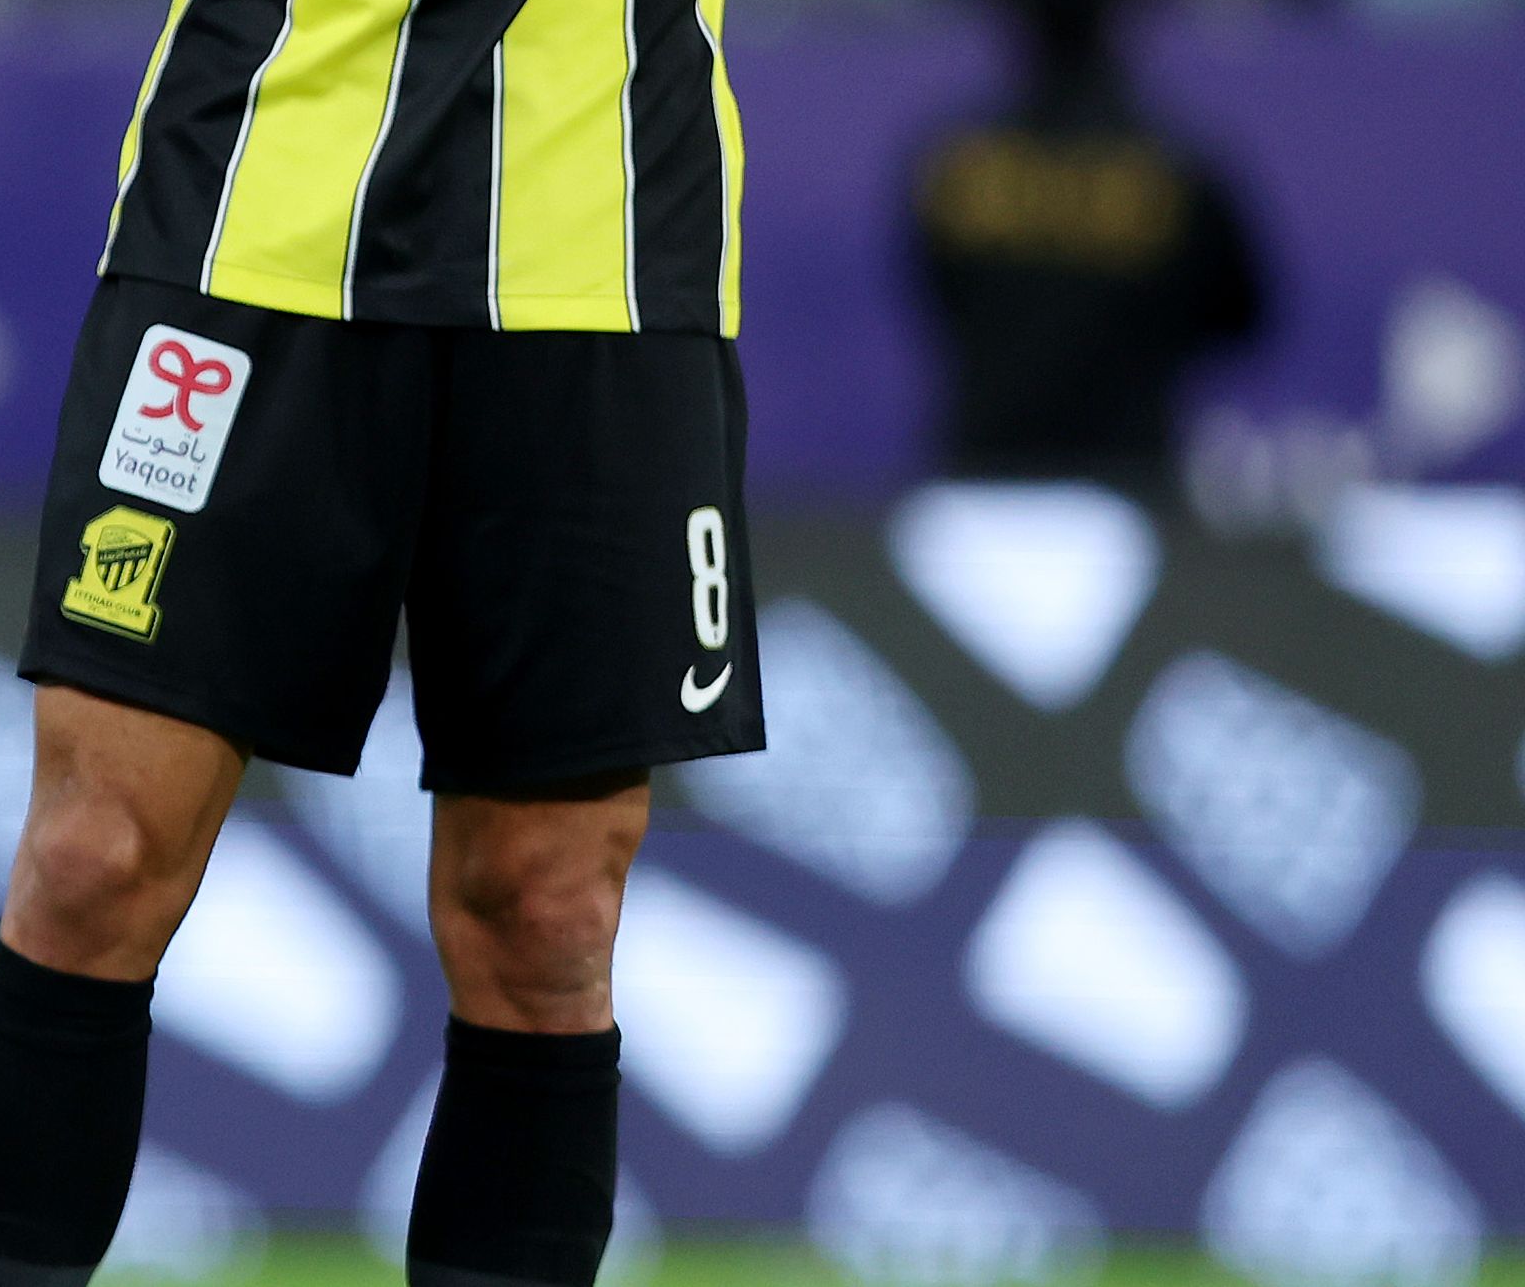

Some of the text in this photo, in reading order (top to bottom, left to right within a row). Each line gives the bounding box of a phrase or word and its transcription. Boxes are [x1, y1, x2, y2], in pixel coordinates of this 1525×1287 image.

[115, 447, 198, 494] Yaqoot
[121, 427, 206, 470] ياقوت
[686, 505, 729, 651] 8
